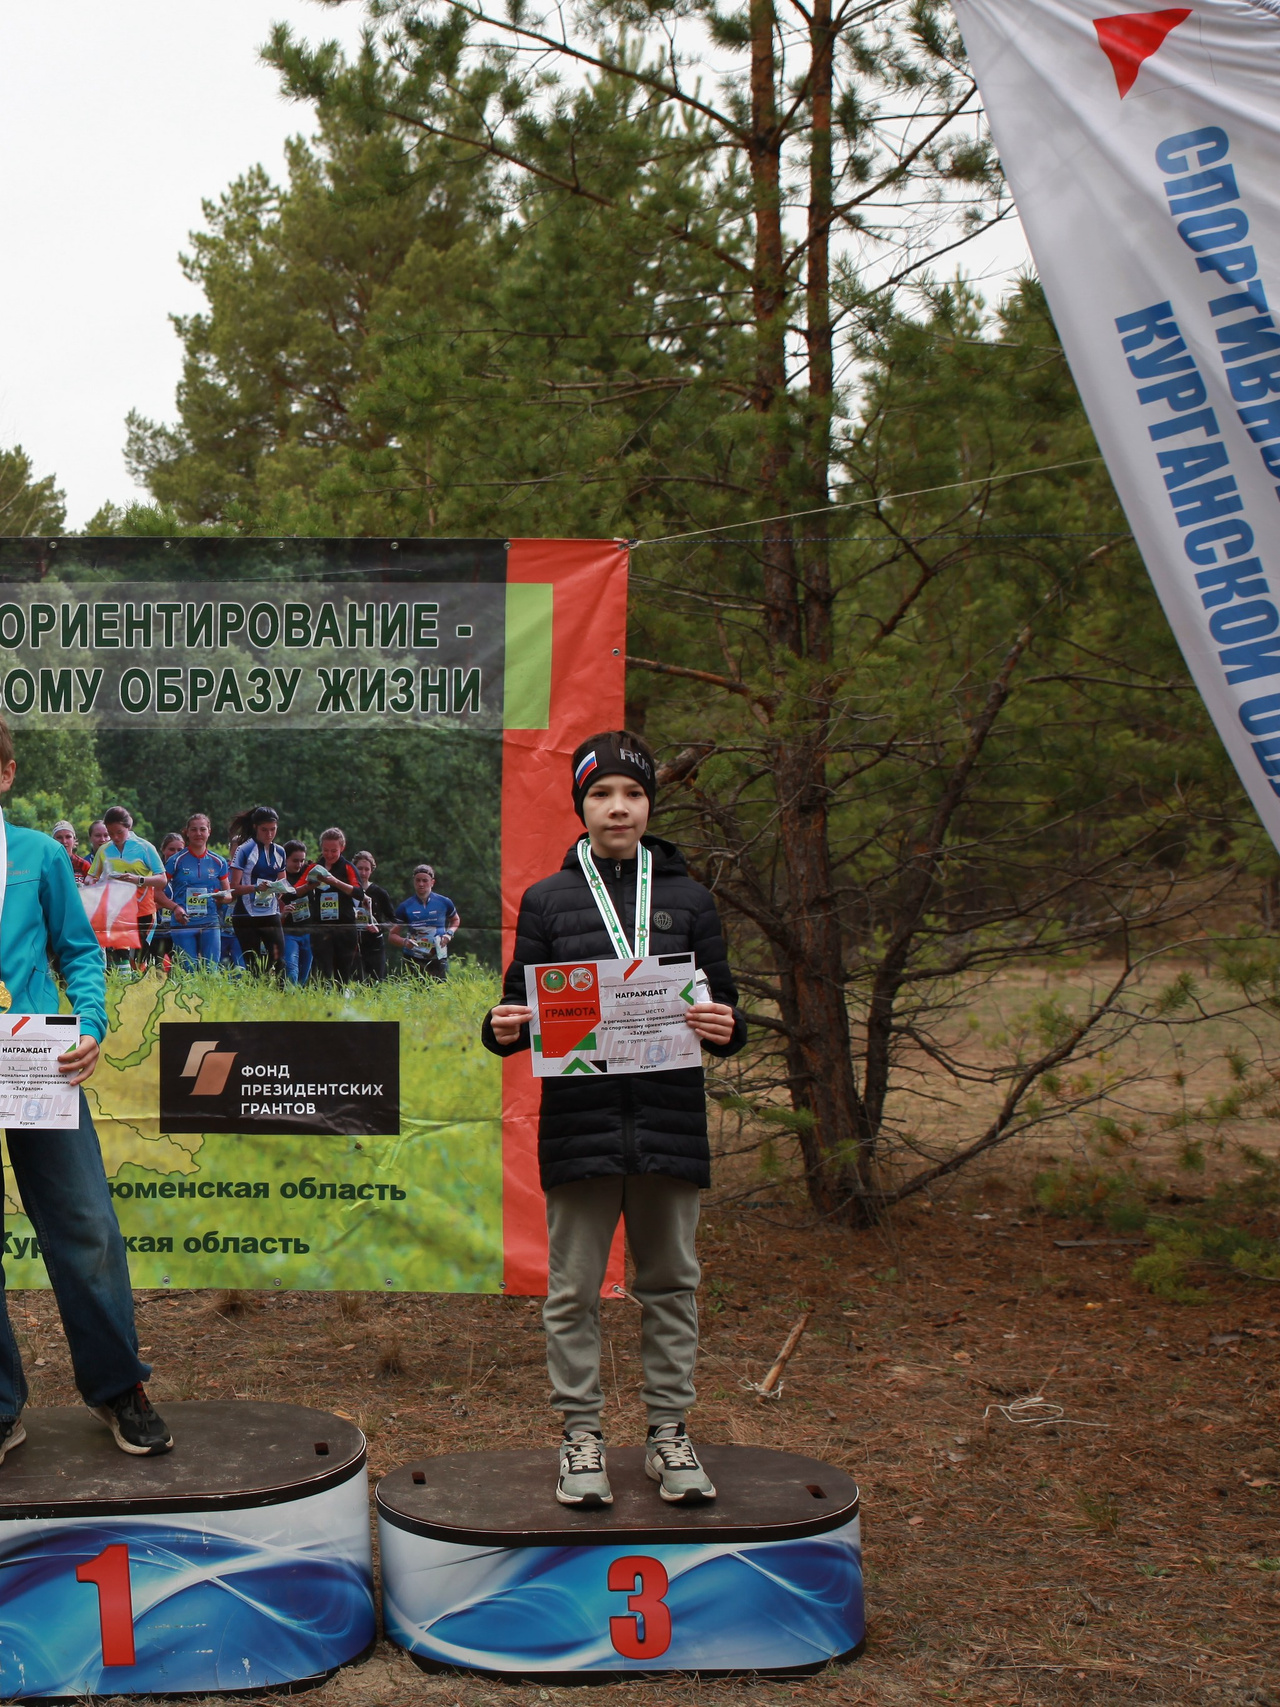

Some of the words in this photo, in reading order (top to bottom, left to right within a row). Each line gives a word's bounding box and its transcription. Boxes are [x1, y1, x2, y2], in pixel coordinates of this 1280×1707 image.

[1155, 126, 1280, 502] СПОРТИВН
[120, 667, 302, 714] ОБРАЗУ
[317, 667, 482, 714] ЖИЗНИ
[615, 988, 667, 999] НАГРАЖДАЕТ
[545, 1007, 596, 1018] ГРАМОТА
[241, 1064, 290, 1079] ФОНД
[241, 1083, 384, 1098] ПРЕЗИДЕНТСКИХ
[241, 1102, 316, 1115] ГРАНТОВ
[108, 1179, 270, 1199] юменская
[280, 1177, 407, 1201] область
[183, 1231, 310, 1255] область
[76, 1544, 135, 1666] 1
[608, 1556, 671, 1659] 3
